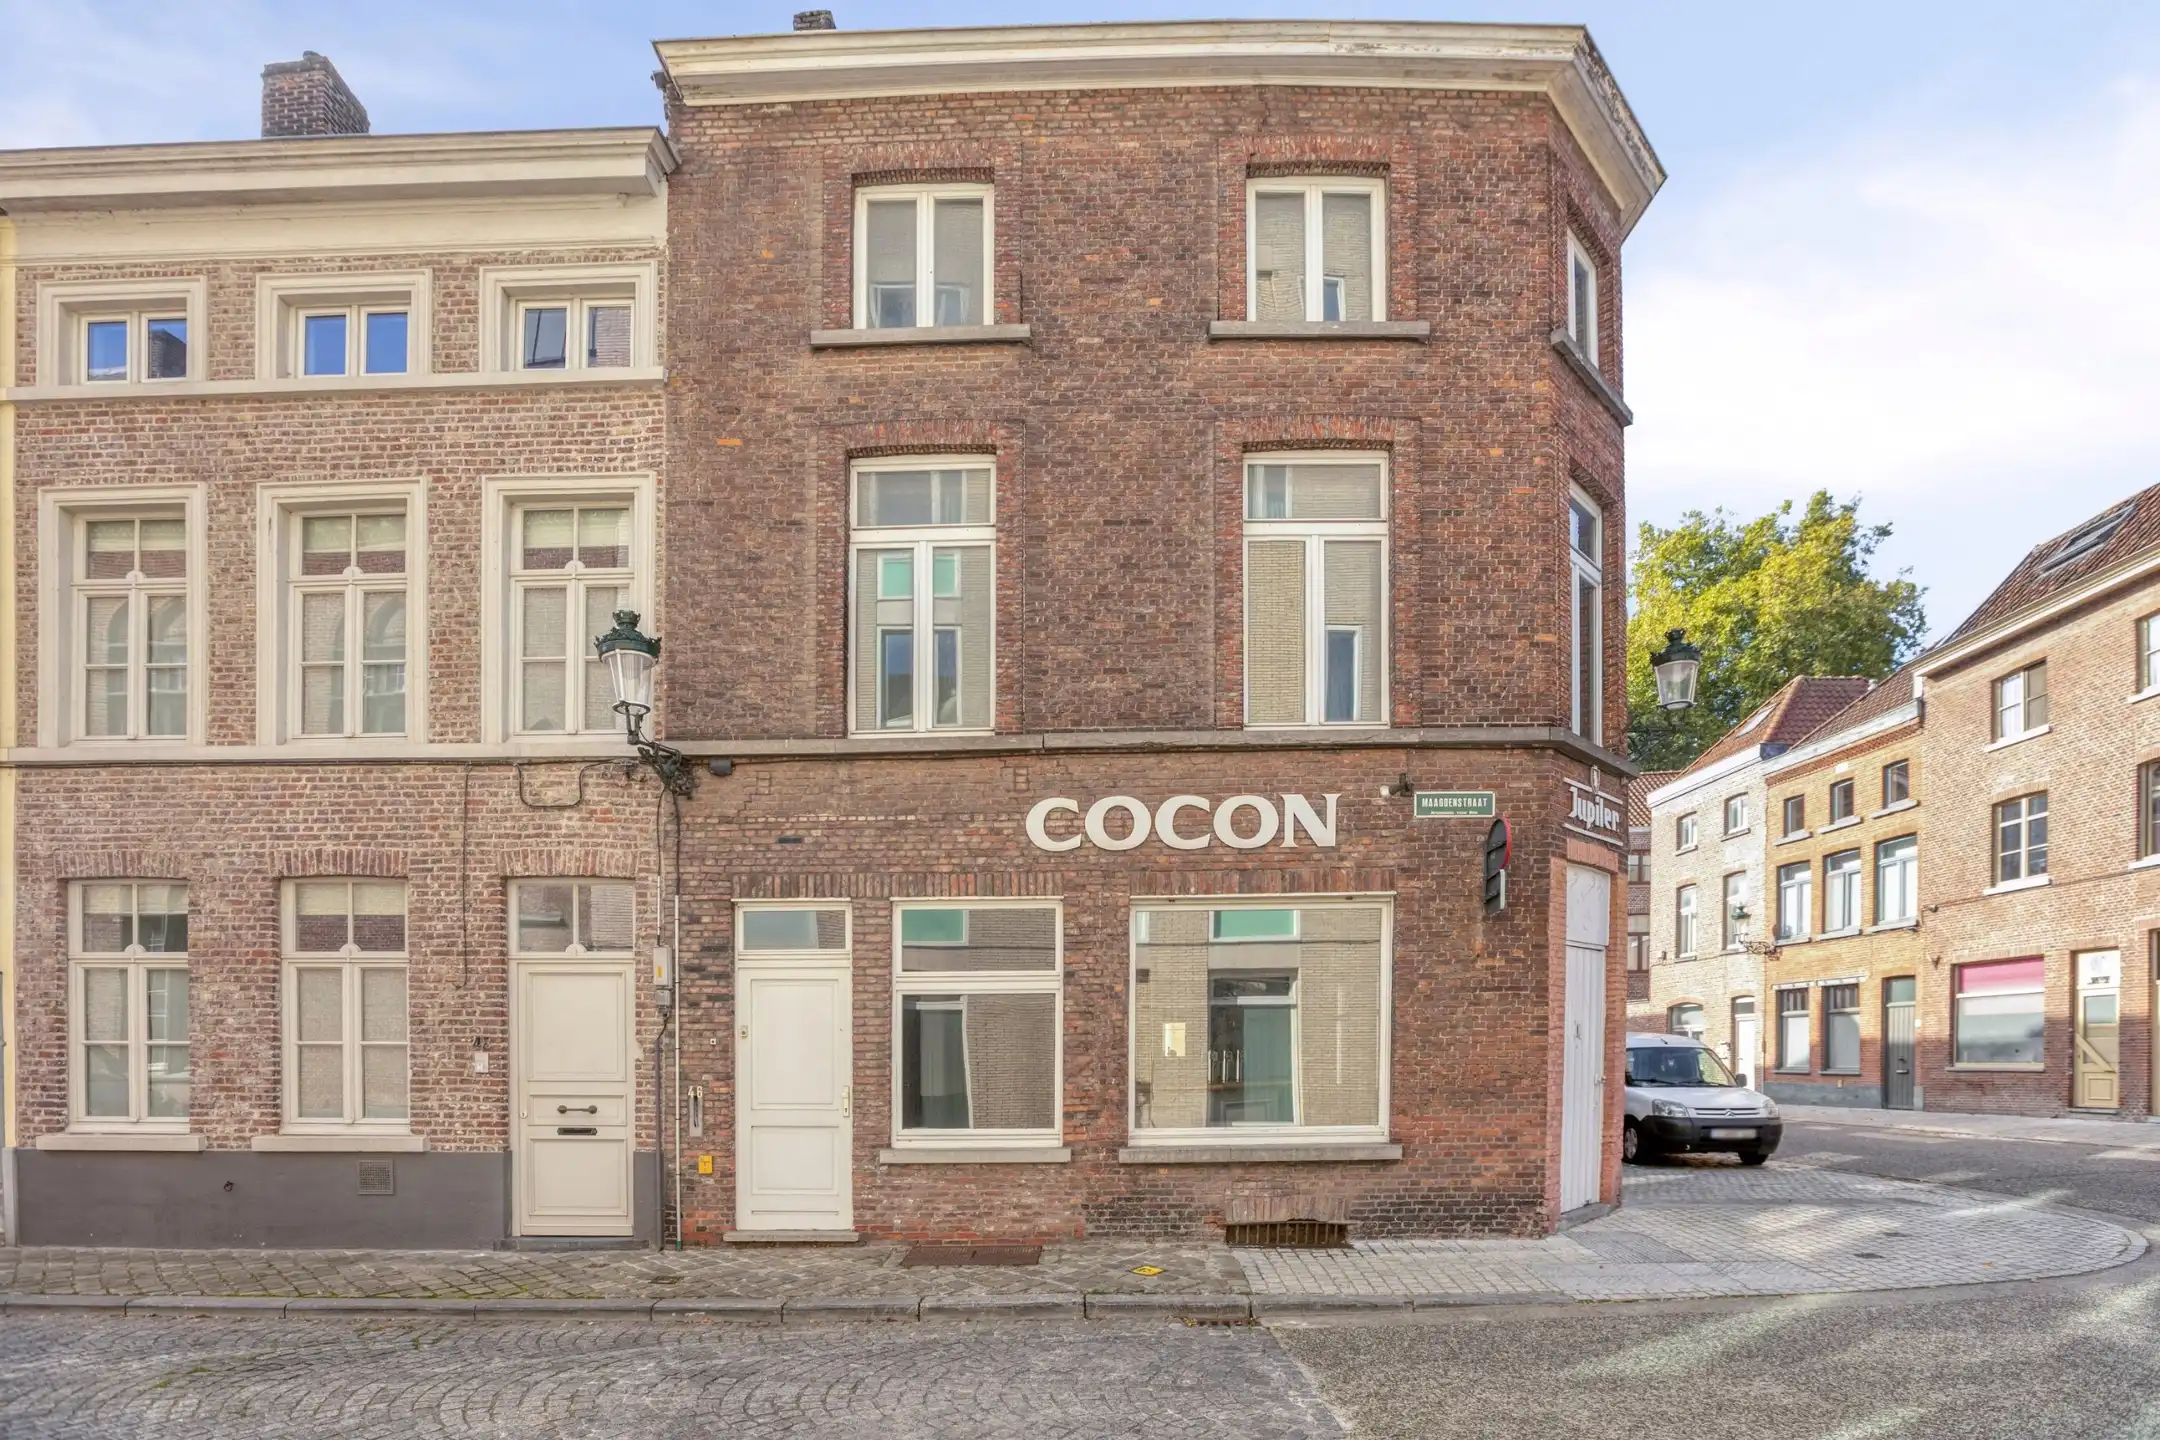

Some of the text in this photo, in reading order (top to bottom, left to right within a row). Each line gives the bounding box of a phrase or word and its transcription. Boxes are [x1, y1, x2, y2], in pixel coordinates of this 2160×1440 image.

[1421, 797, 1488, 808] MAAGDENSTRAAT
[1567, 786, 1619, 832] Jupiler
[1025, 793, 1342, 851] COCON
[687, 1085, 704, 1098] 46
